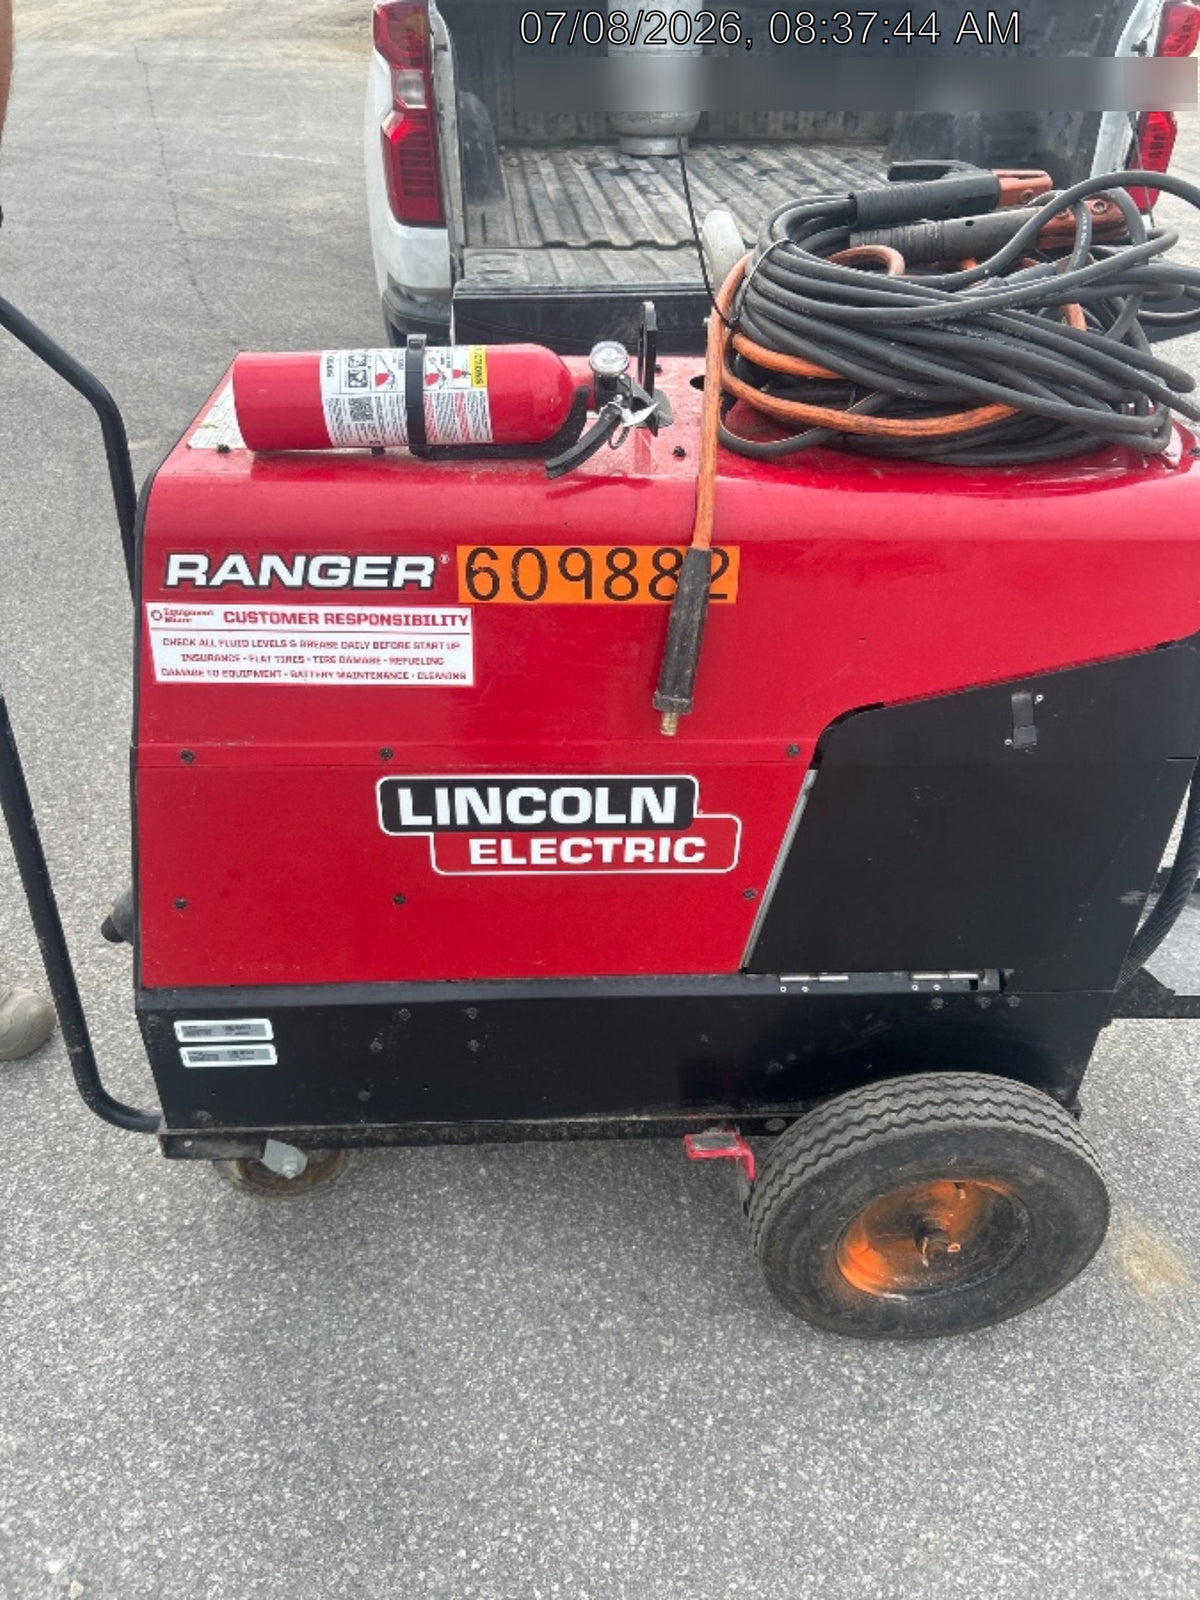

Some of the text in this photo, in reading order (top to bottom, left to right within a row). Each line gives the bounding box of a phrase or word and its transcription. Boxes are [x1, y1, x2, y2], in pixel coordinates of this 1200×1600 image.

[165, 553, 436, 590] RANGER
[465, 547, 730, 601] 609882
[223, 611, 468, 626] CUSTOMER RESPONSIBILITY
[163, 638, 196, 647] CHECK
[199, 639, 216, 647] ALL
[219, 640, 249, 648] FLUID
[252, 640, 287, 648] LEVELS
[341, 641, 370, 650] DAILY
[373, 641, 410, 650] BEFORE
[413, 641, 444, 650] START
[447, 642, 461, 650] UP
[181, 654, 240, 662] INSURANCE
[249, 655, 271, 663] FLAT
[275, 655, 305, 664] TIRES
[312, 655, 336, 664] TIRE
[389, 657, 445, 665] REFUELING
[207, 669, 219, 677] TO
[222, 669, 282, 678] EQUIPMENT
[290, 670, 334, 679] BATTERY
[336, 671, 409, 680] MAINTENANCE
[417, 672, 466, 680] CLEANING
[397, 787, 677, 825] LINCOLN
[469, 837, 707, 865] ELECTRIC
